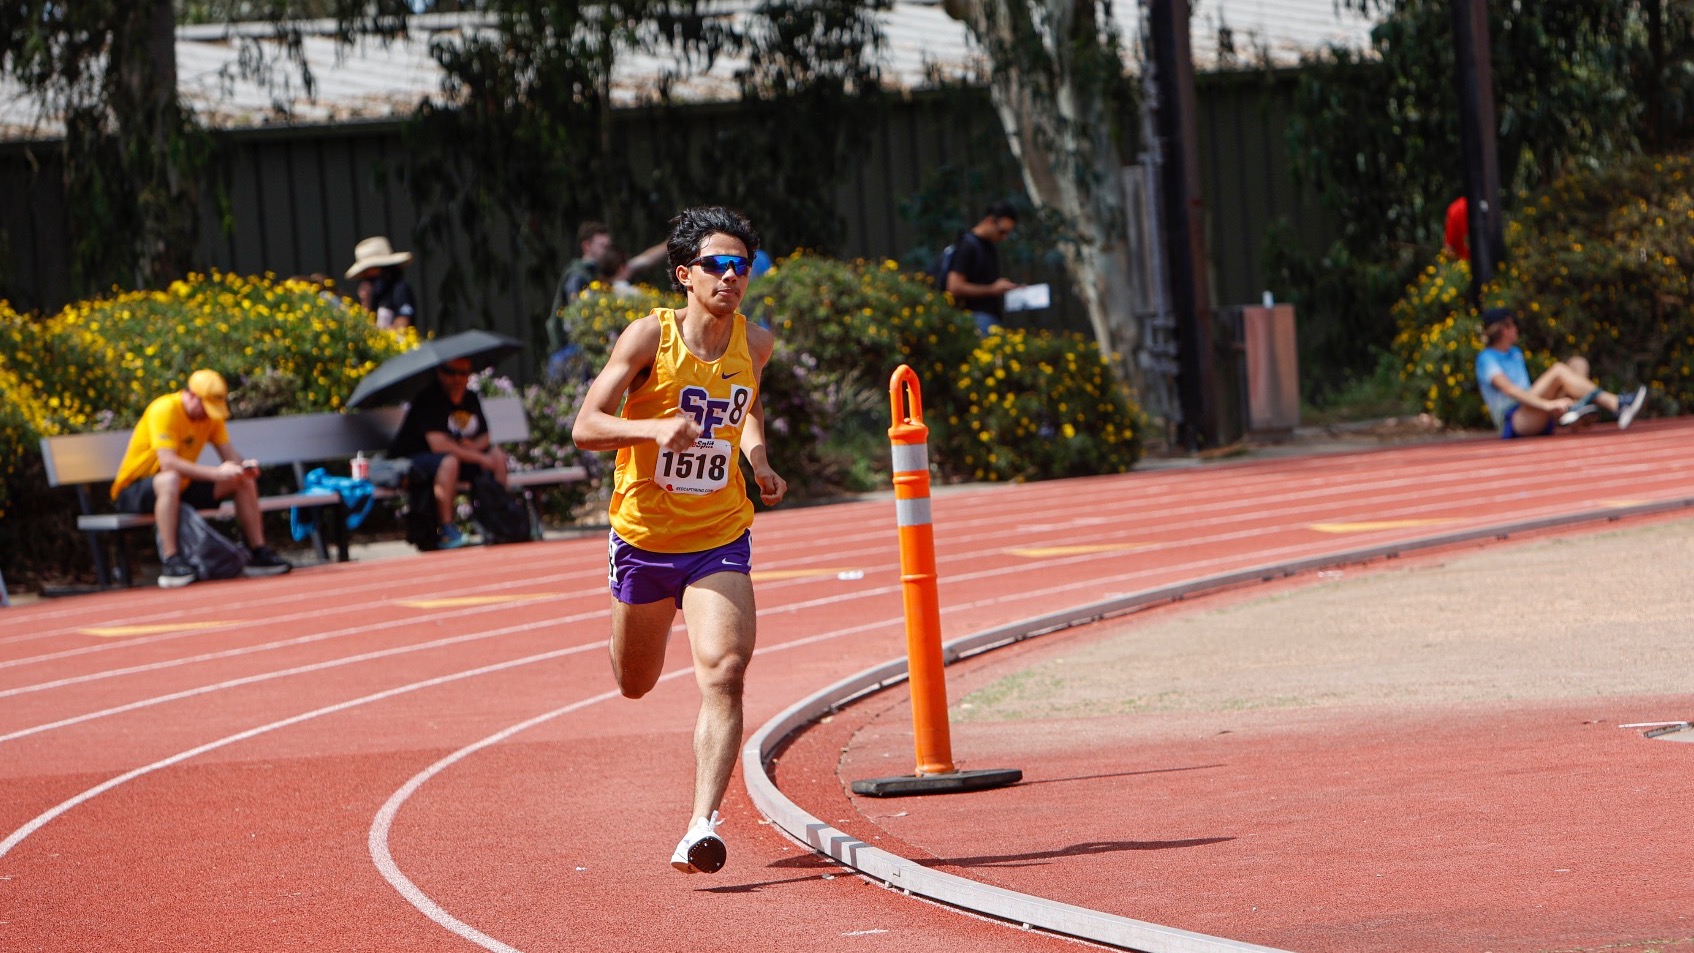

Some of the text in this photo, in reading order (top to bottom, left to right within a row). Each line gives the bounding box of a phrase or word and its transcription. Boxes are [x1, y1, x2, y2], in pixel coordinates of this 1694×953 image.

[679, 386, 730, 439] SF
[729, 388, 748, 425] 8
[662, 451, 727, 481] 1518
